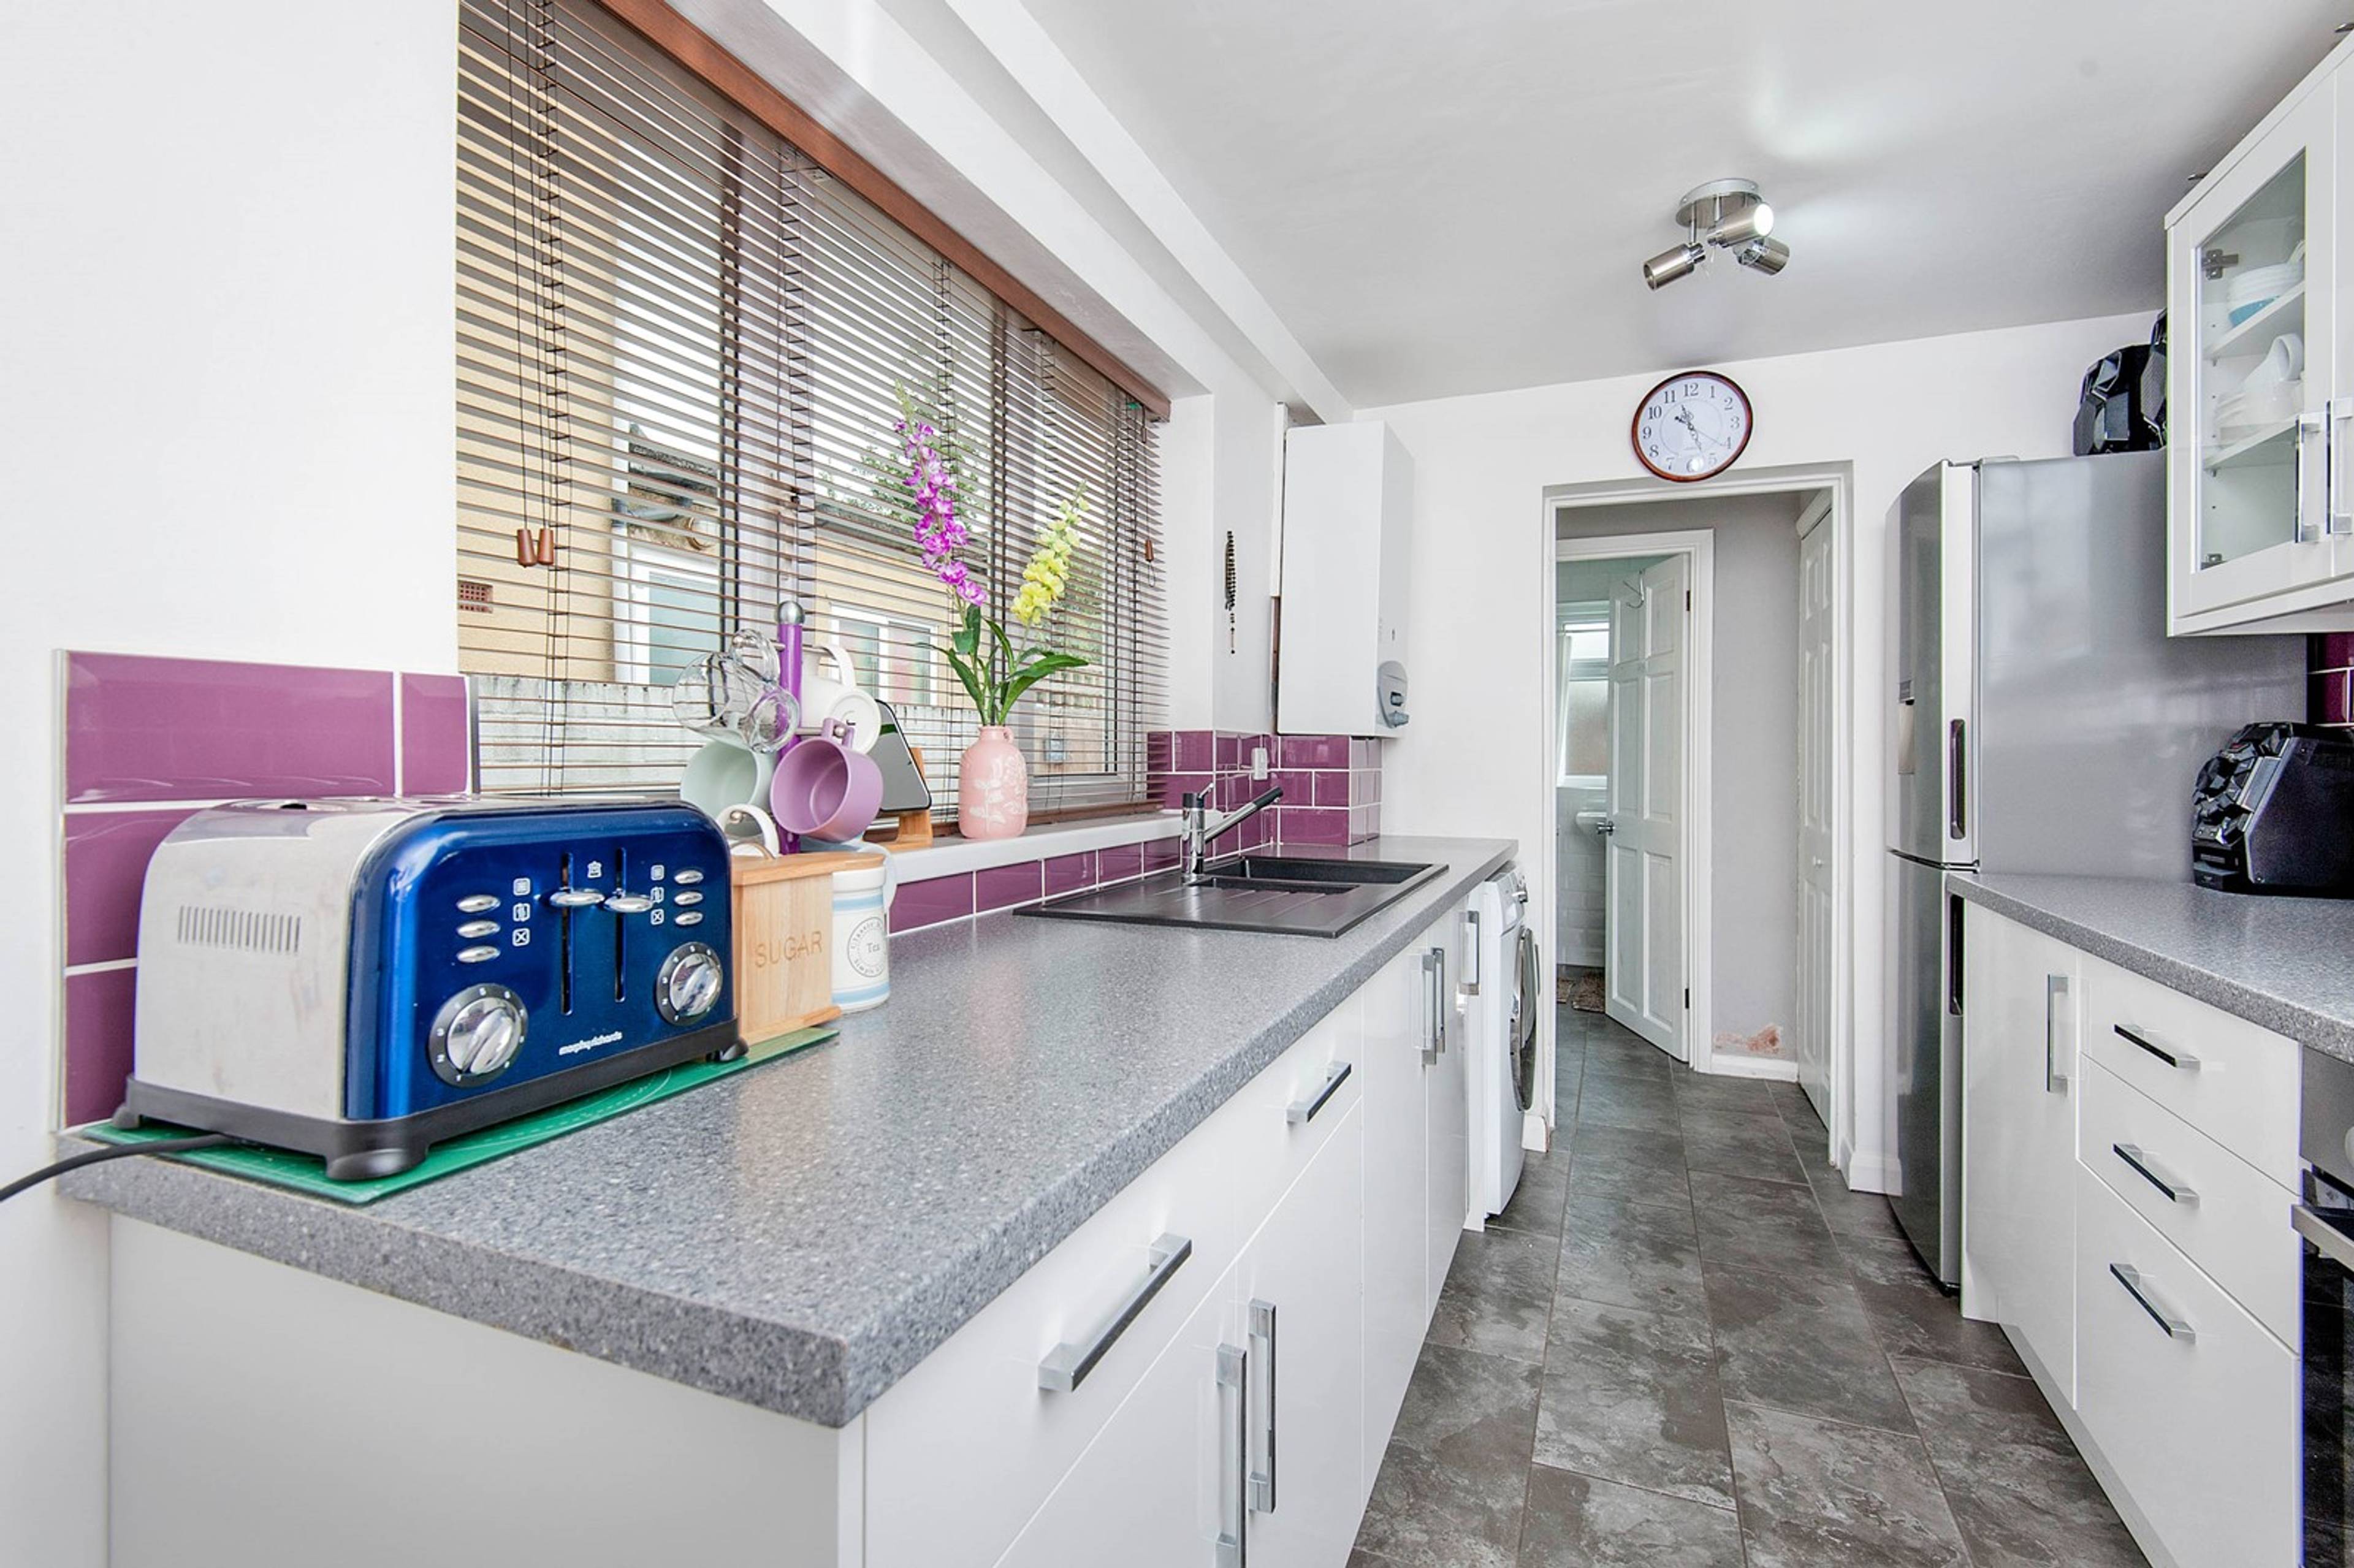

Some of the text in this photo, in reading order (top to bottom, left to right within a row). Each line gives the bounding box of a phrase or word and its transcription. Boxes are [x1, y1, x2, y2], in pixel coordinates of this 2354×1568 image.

[1684, 382, 1699, 397] 12
[1710, 385, 1715, 398] 1
[1664, 390, 1676, 404] 11
[1724, 397, 1733, 411] 2
[1648, 406, 1662, 420] 10
[1730, 416, 1740, 429] 3
[1643, 426, 1652, 440] 9
[1649, 444, 1659, 457] 8
[755, 931, 823, 969] SUGAR
